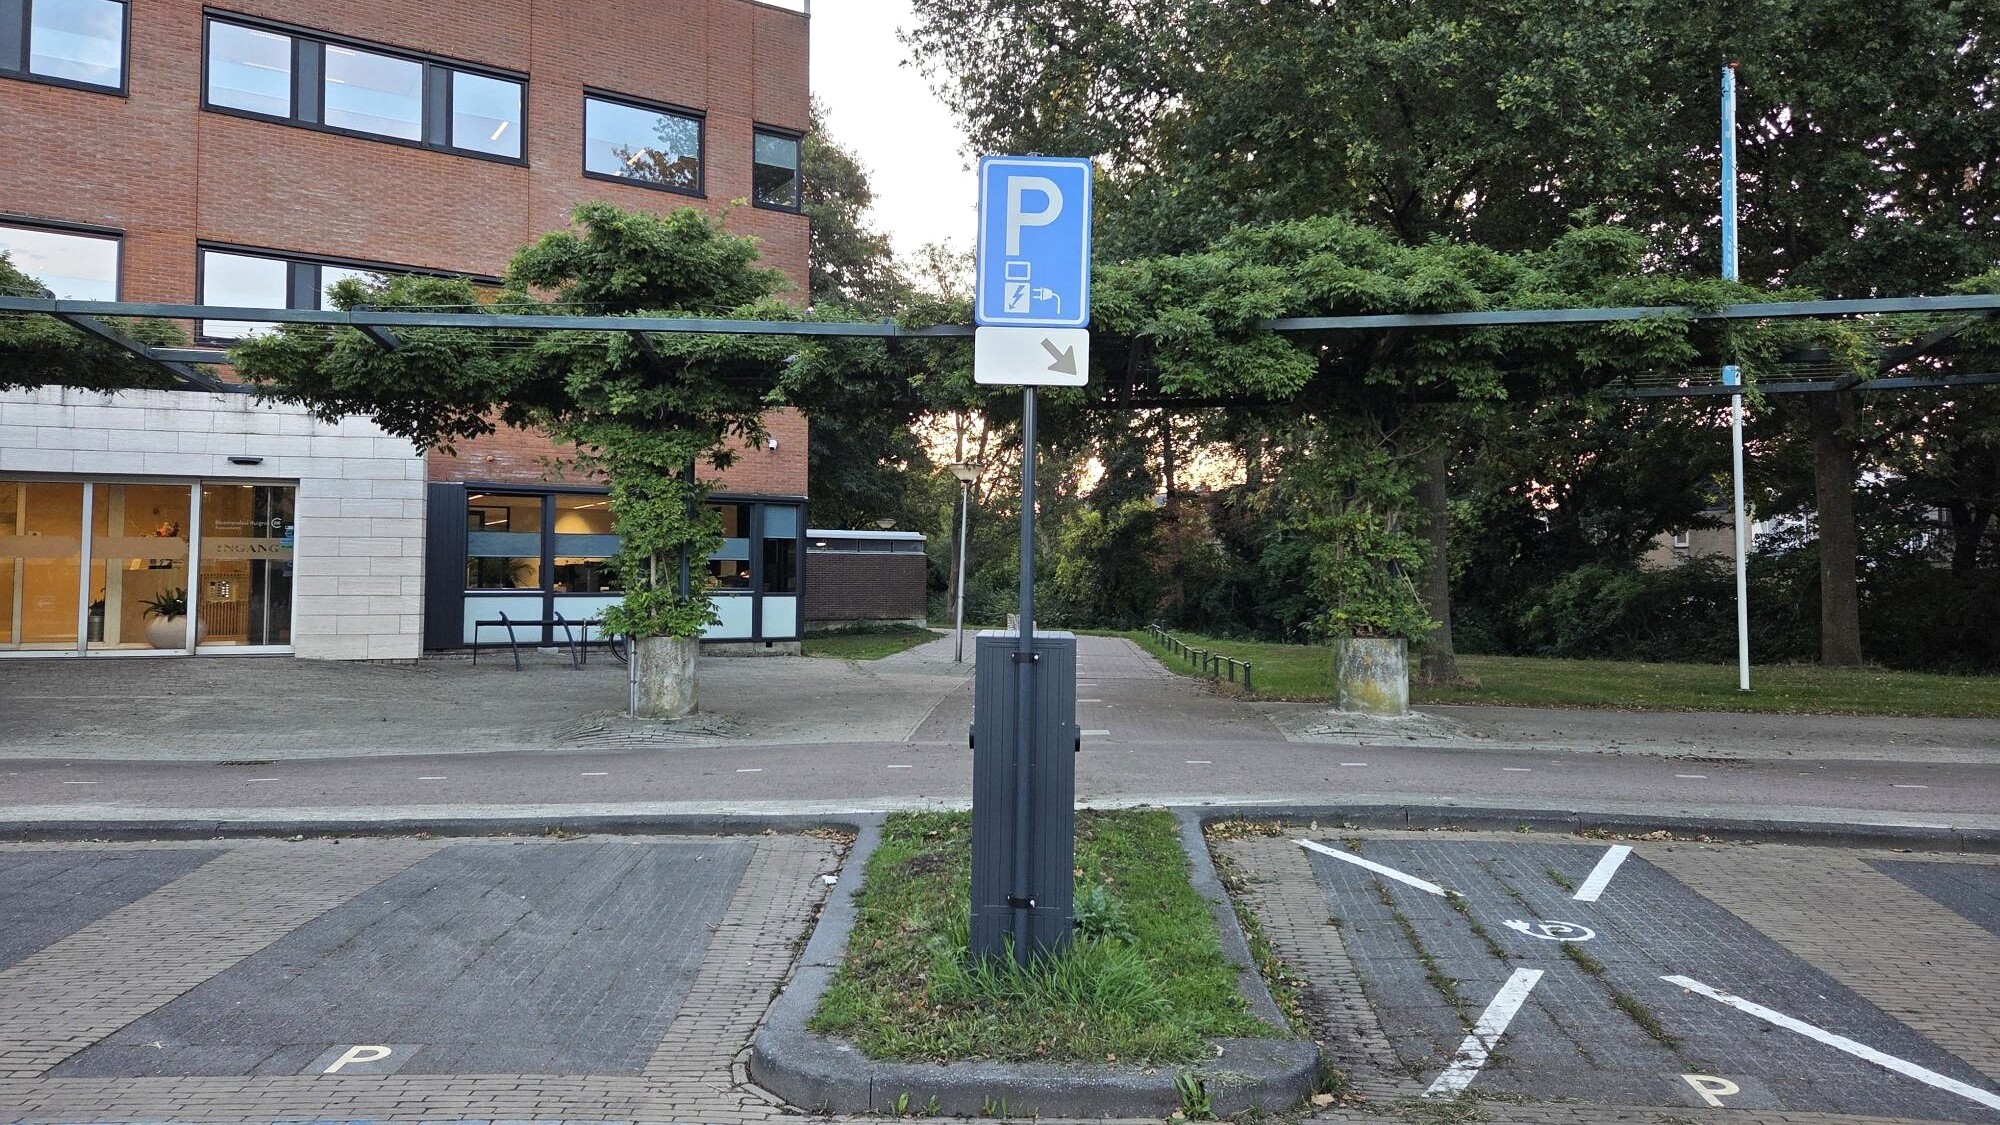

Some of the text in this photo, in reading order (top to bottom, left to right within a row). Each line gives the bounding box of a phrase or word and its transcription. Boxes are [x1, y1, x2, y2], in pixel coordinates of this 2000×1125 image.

[1006, 175, 1063, 256] P
[323, 1045, 392, 1073] P
[1680, 1074, 1740, 1107] P
